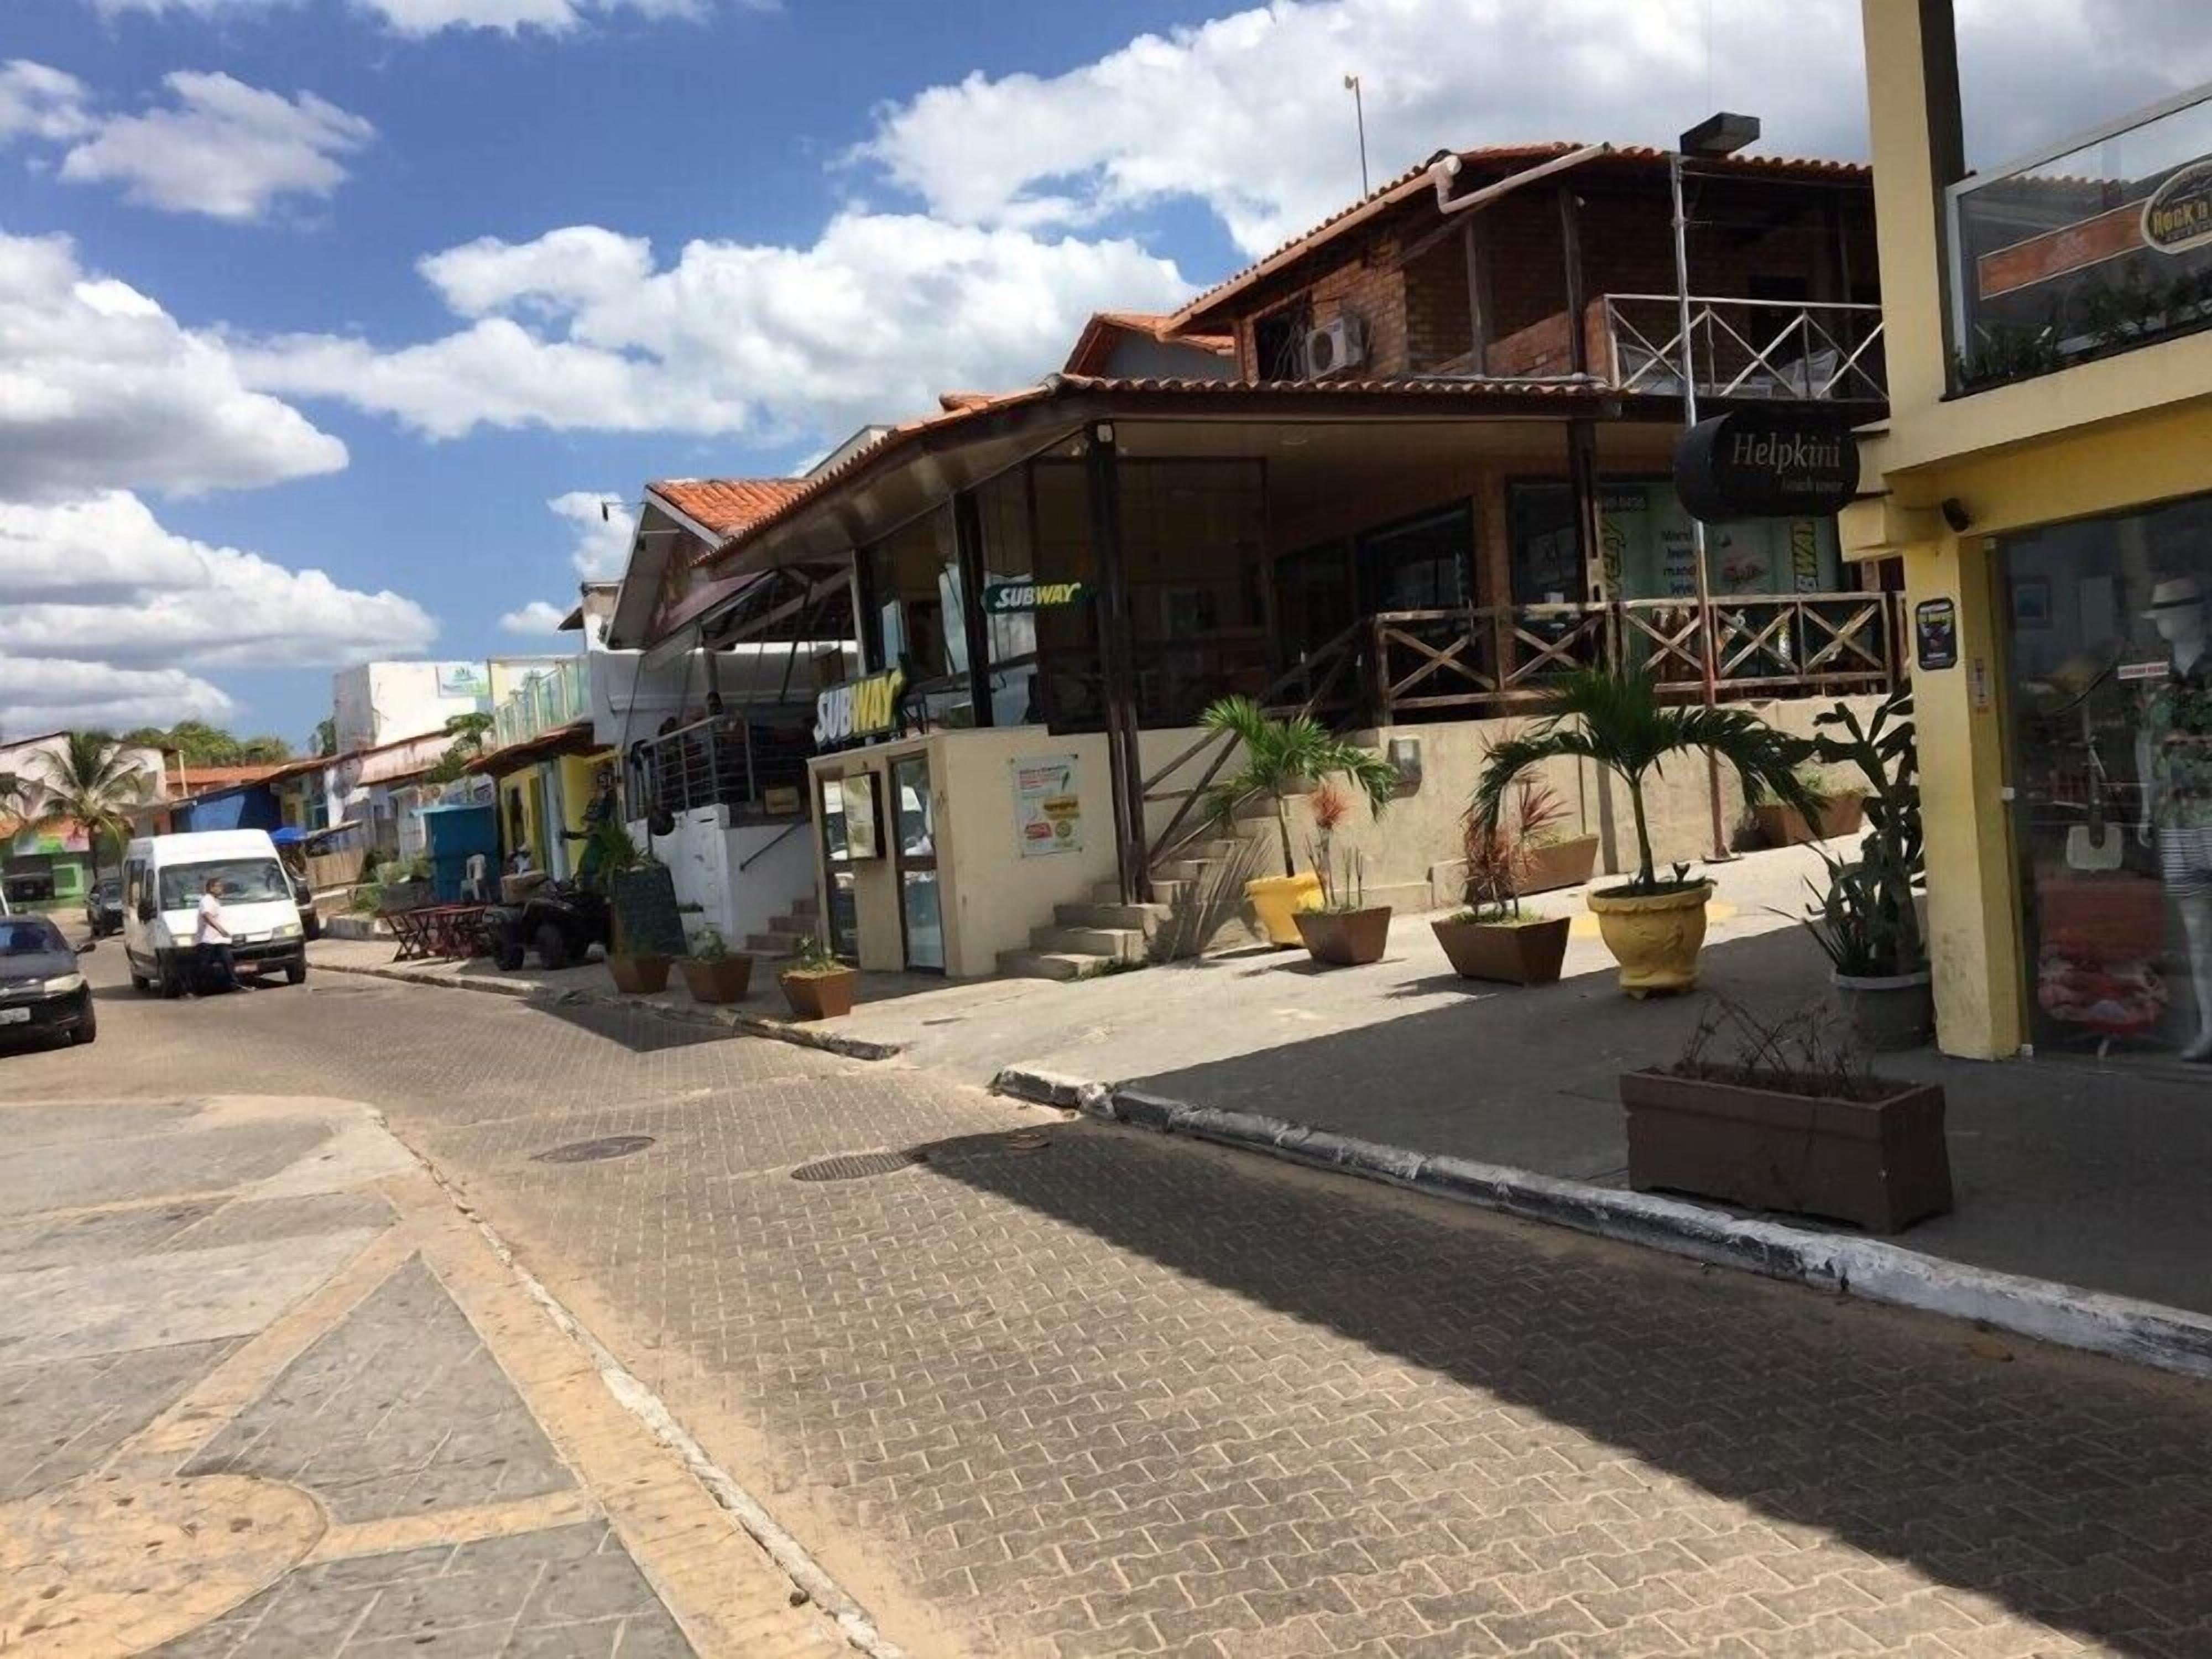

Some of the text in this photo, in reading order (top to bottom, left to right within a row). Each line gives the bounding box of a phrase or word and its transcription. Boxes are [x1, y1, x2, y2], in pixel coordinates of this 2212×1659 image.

[1731, 431, 1841, 474] Helpkini
[996, 582, 1082, 608] SUBWAY
[814, 668, 902, 742] SUBWAY
